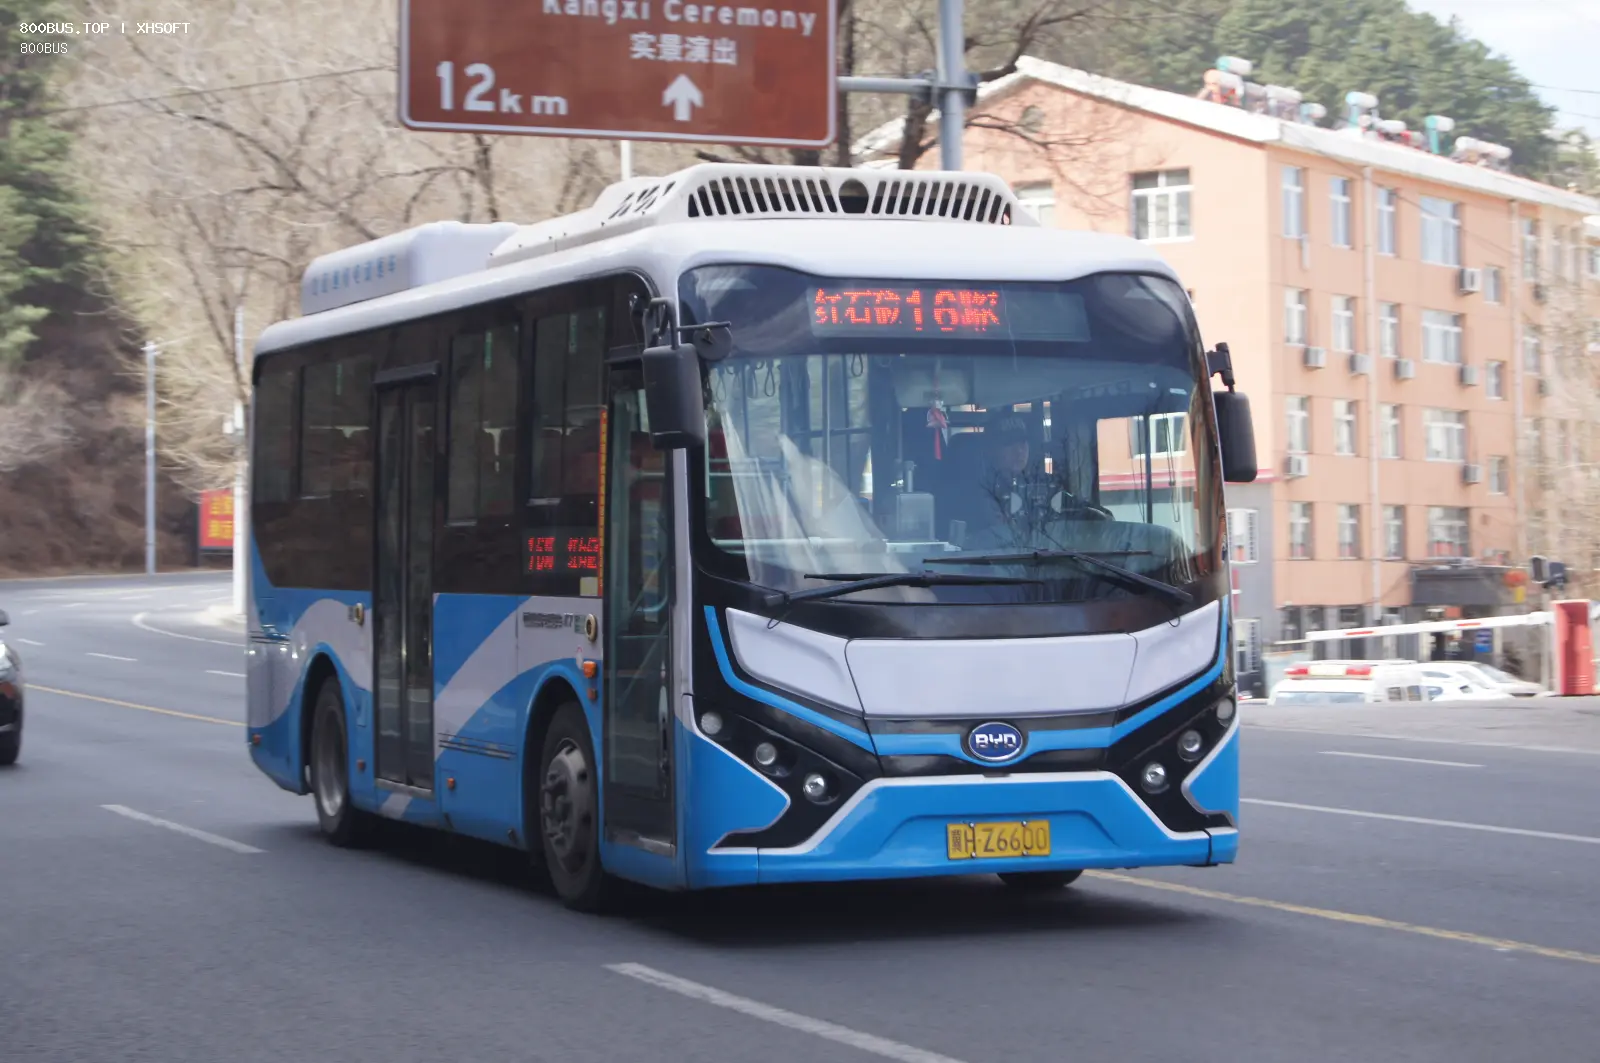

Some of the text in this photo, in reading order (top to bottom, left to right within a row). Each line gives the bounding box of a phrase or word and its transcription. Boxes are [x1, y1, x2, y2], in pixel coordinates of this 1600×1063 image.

[663, 0, 816, 36] Ceremony
[629, 32, 737, 65] 实景演出
[975, 733, 1017, 748] BYD
